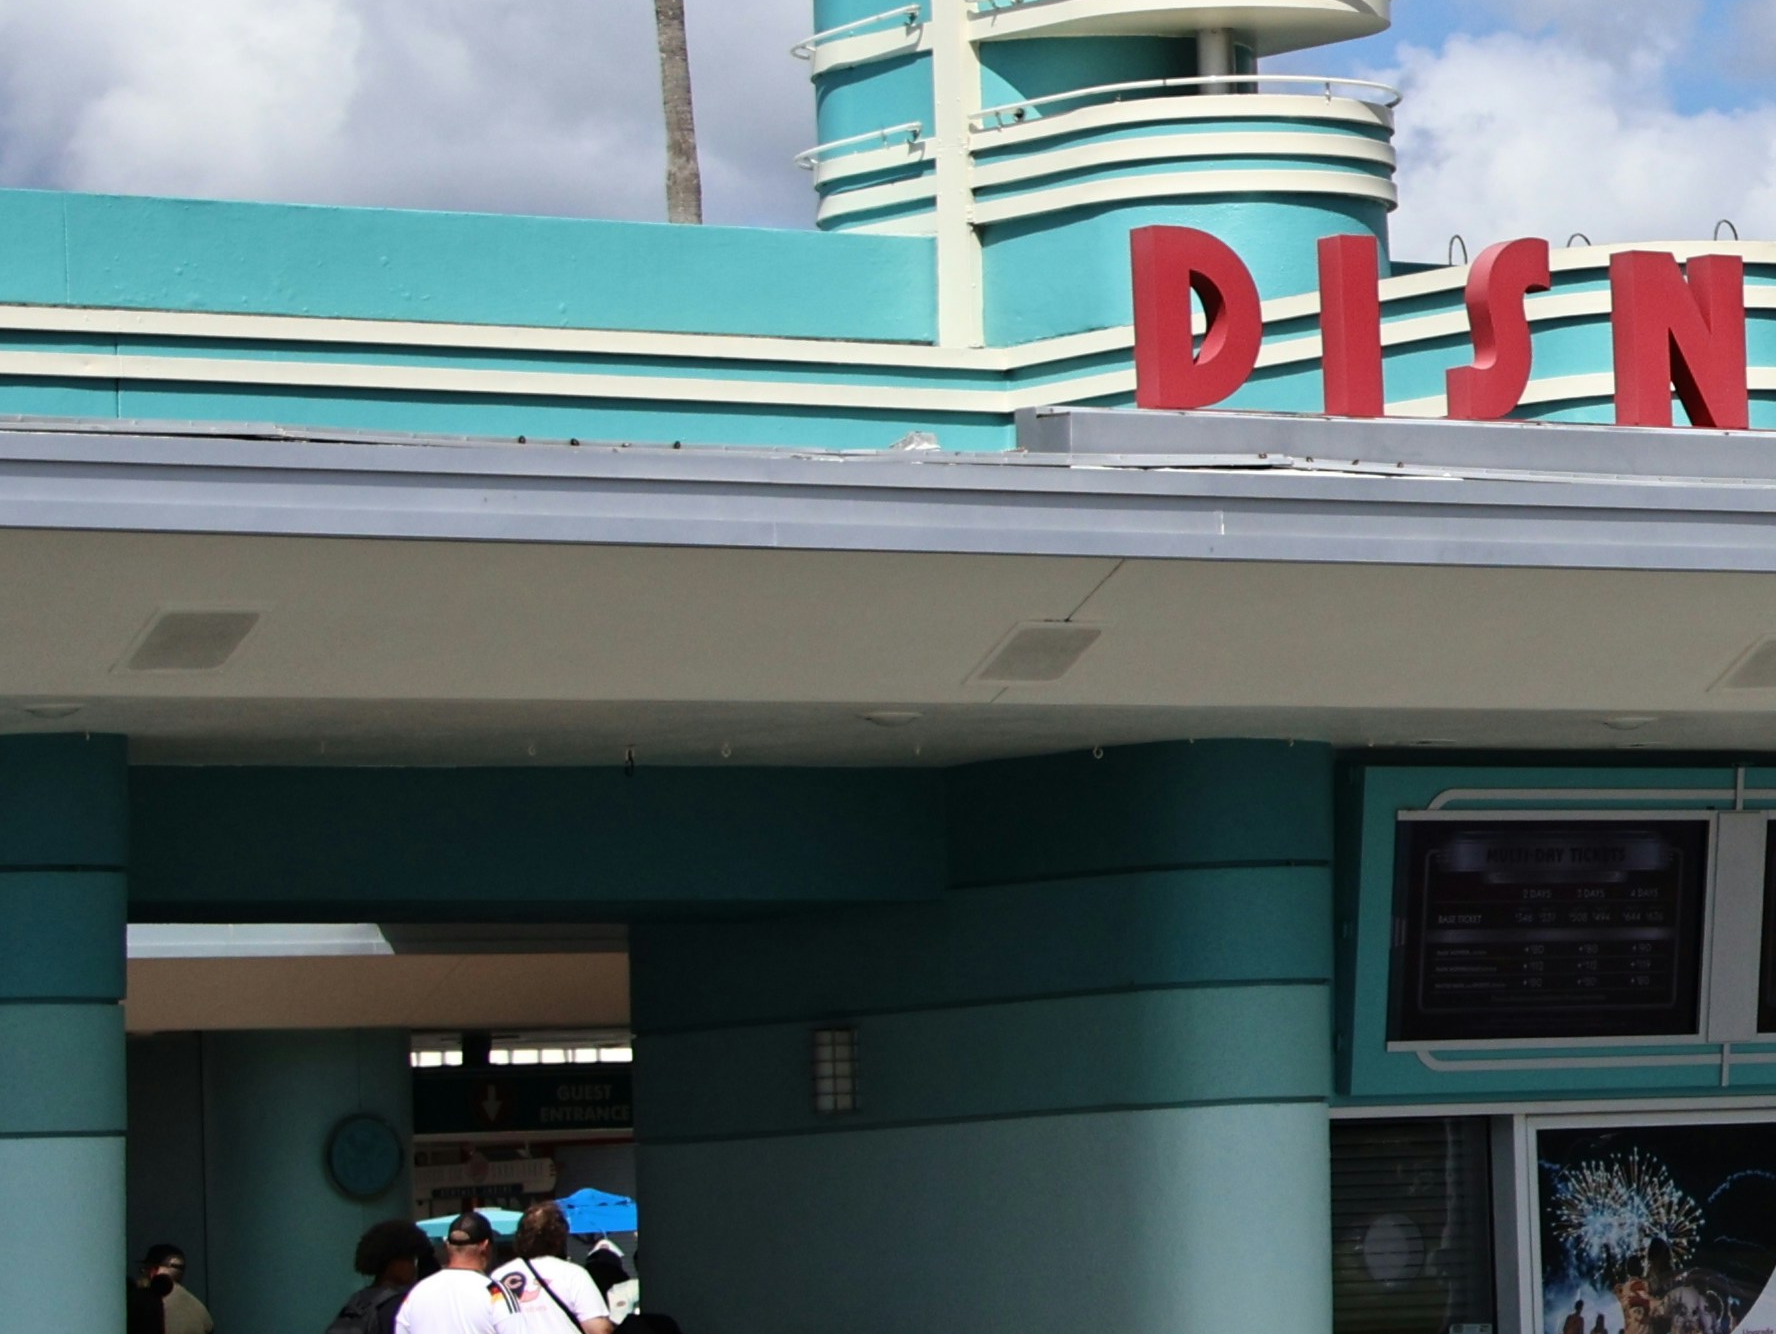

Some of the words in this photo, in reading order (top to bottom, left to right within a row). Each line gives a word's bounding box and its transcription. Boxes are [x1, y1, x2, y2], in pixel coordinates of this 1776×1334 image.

[1485, 847, 1563, 864] MULTI-DAY
[1570, 846, 1627, 863] TICKETS
[557, 1084, 612, 1101] GUEST
[540, 1104, 630, 1122] ENTRANCE
